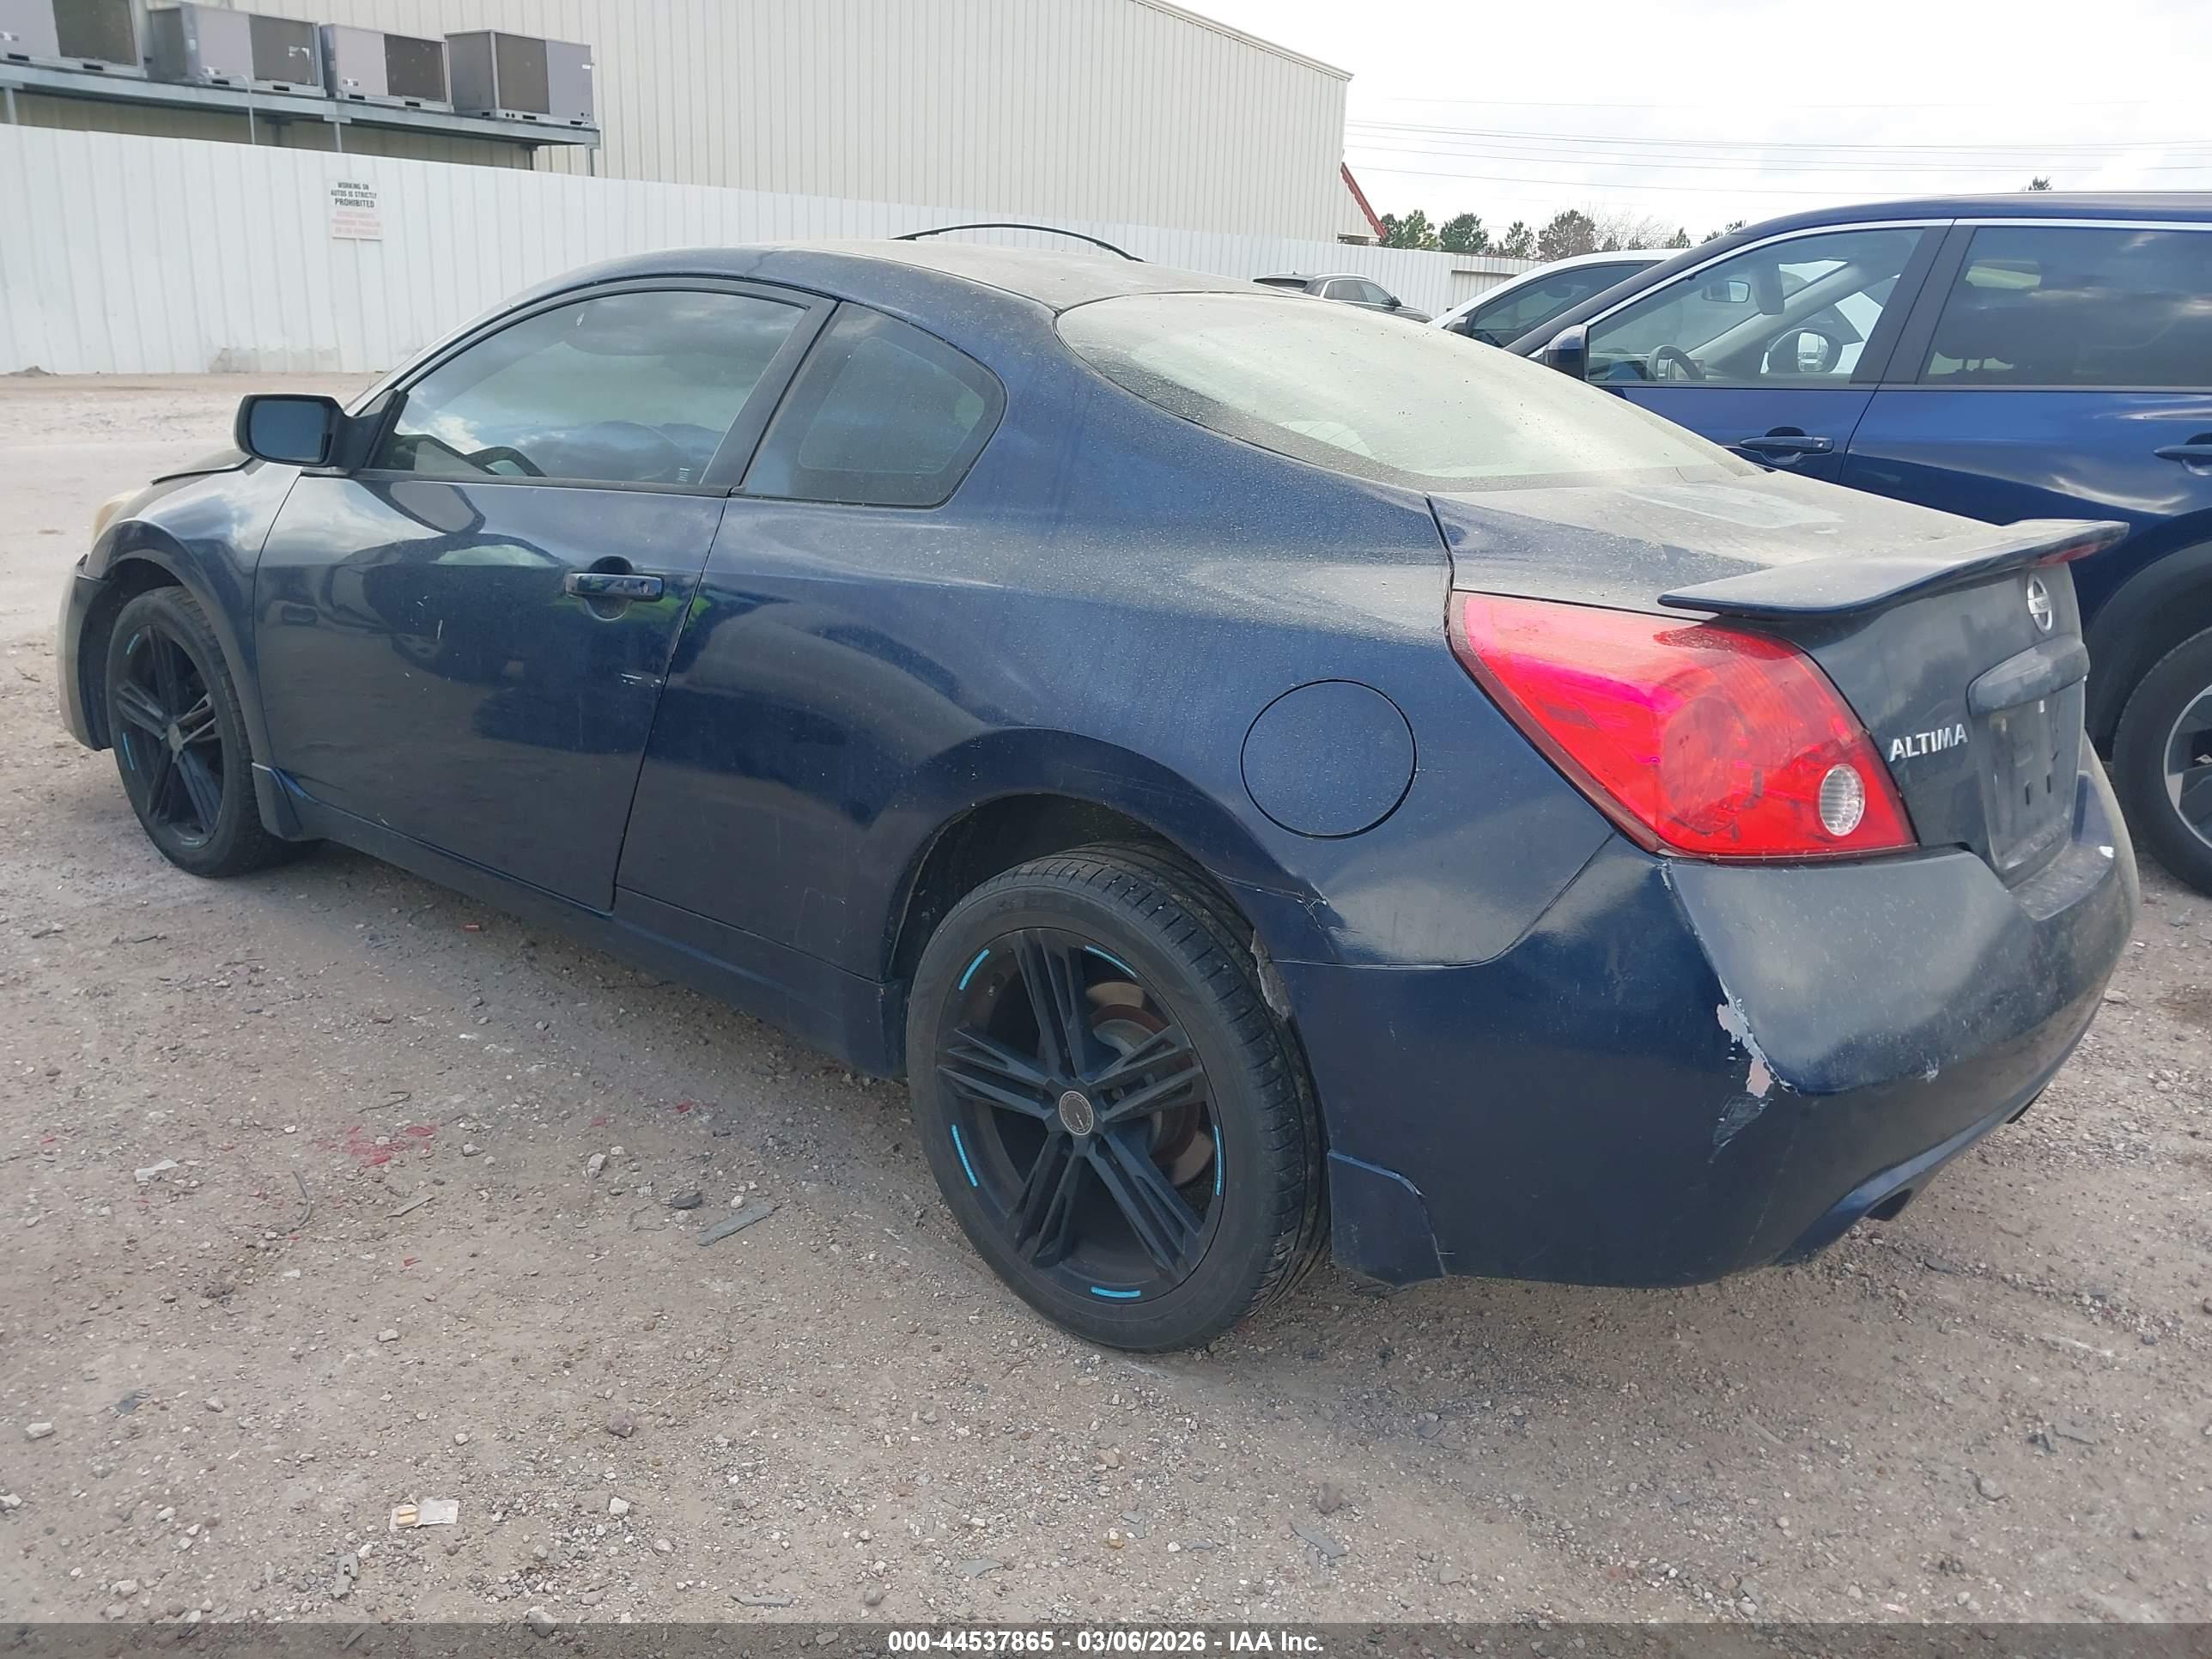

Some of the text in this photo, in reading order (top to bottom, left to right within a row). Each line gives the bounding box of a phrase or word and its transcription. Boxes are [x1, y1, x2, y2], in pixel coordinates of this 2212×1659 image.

[331, 189, 347, 198] AUTOS
[355, 191, 377, 199] STRICTLY
[335, 198, 375, 208] PROHIBITED
[1889, 723, 1969, 763] ALTIMA
